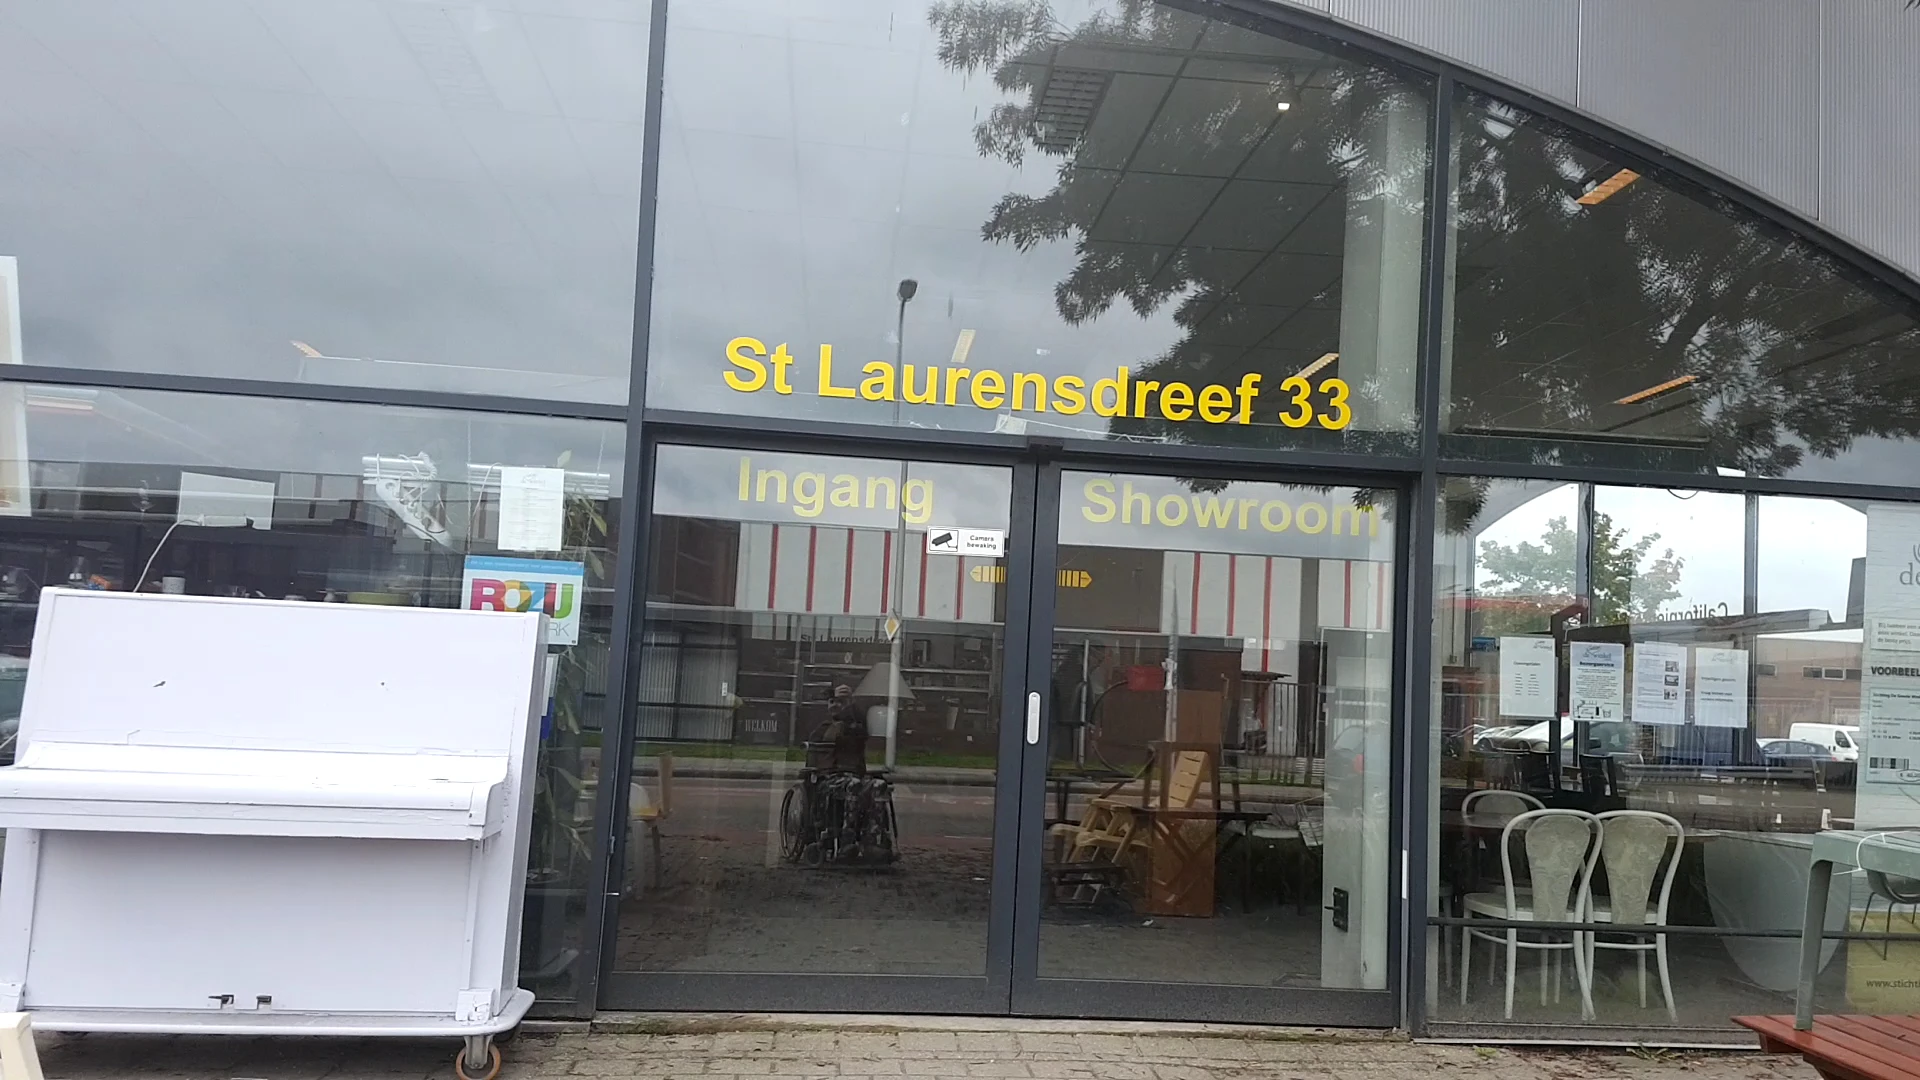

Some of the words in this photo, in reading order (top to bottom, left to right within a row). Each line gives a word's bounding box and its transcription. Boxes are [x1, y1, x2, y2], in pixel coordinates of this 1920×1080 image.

[722, 336, 794, 395] St
[818, 343, 1263, 425] Laurensdreef
[1278, 376, 1352, 430] 33
[738, 456, 934, 524] Ingang
[1081, 478, 1378, 537] Showroom
[969, 534, 995, 542] Camera
[966, 542, 997, 550] bewaking
[1870, 665, 1920, 677] VOORBEEL
[745, 719, 778, 732] WELKOM
